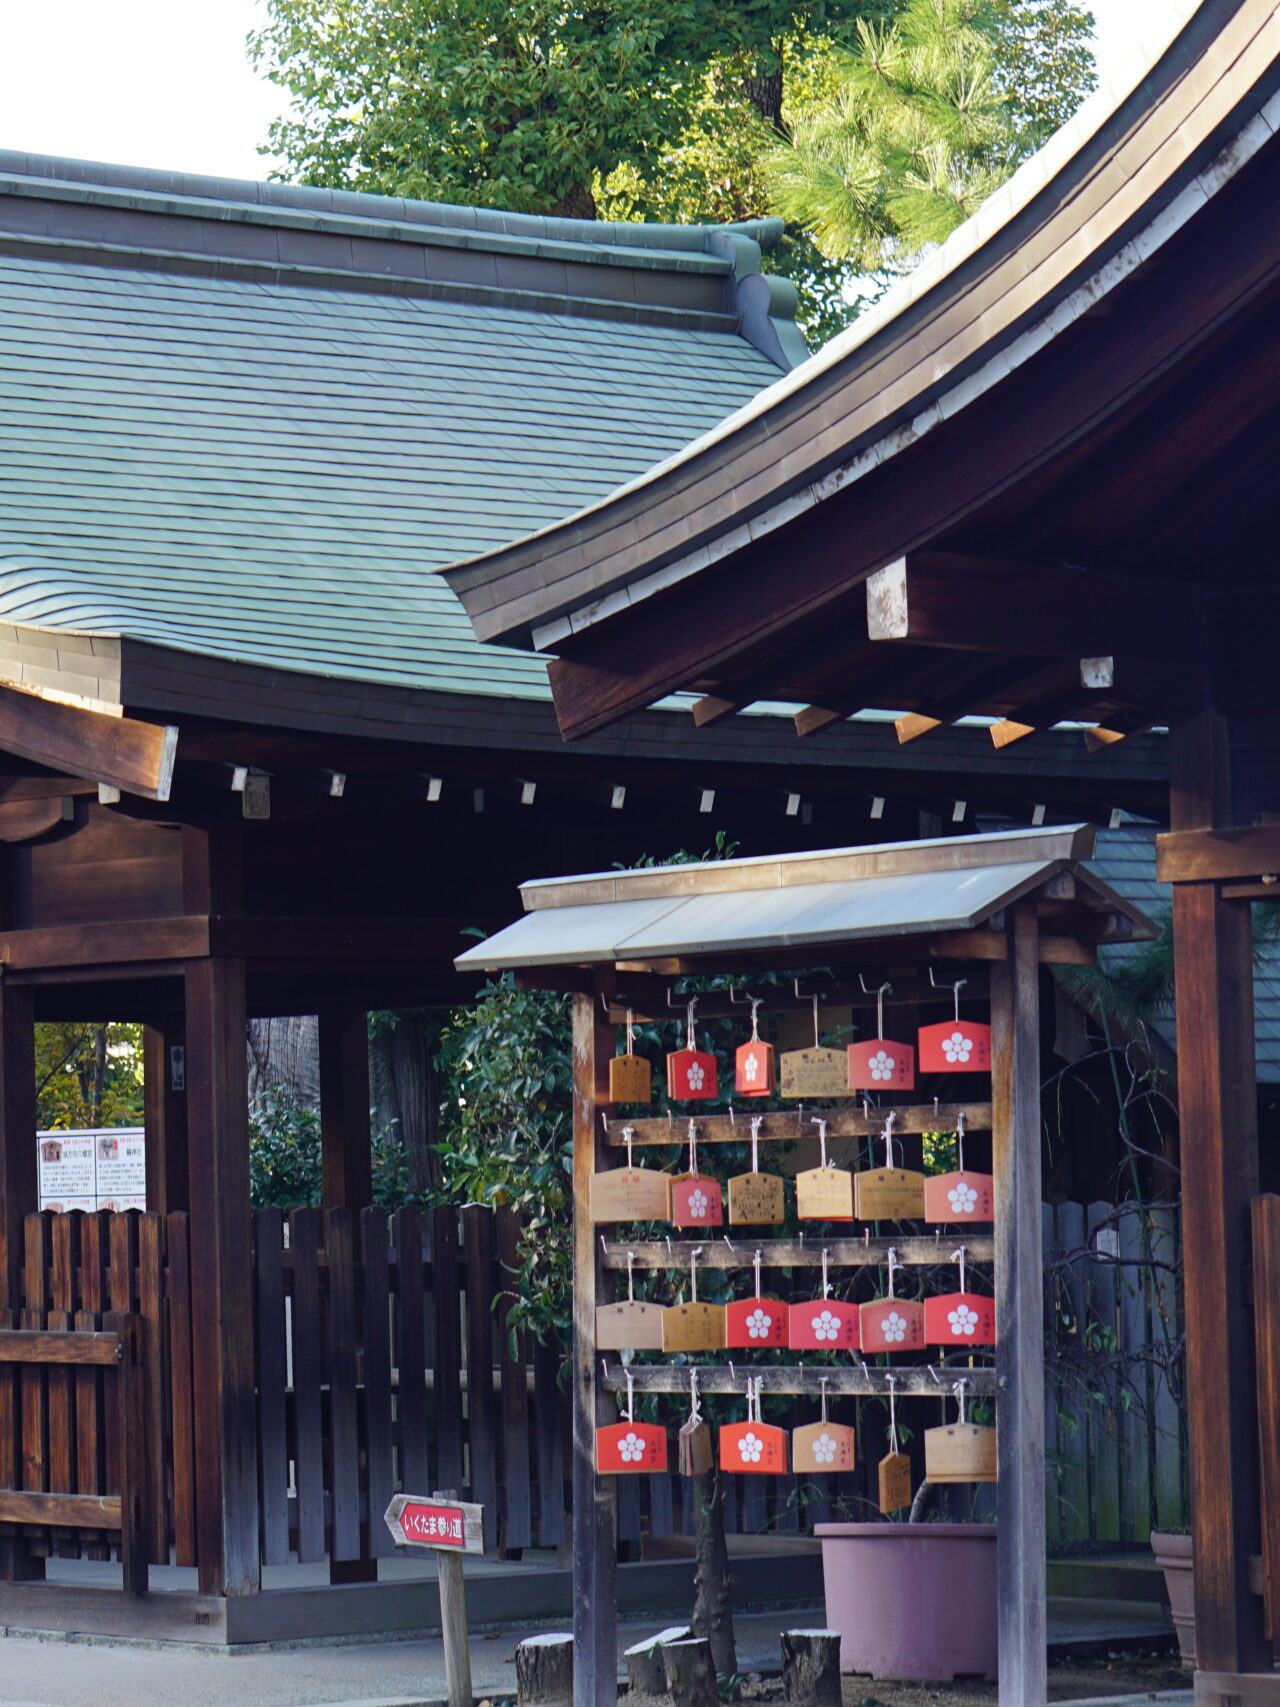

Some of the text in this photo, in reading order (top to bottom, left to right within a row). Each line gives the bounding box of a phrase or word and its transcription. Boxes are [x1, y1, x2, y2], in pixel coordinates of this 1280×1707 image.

[404, 1513, 462, 1539] いくたま参り道
